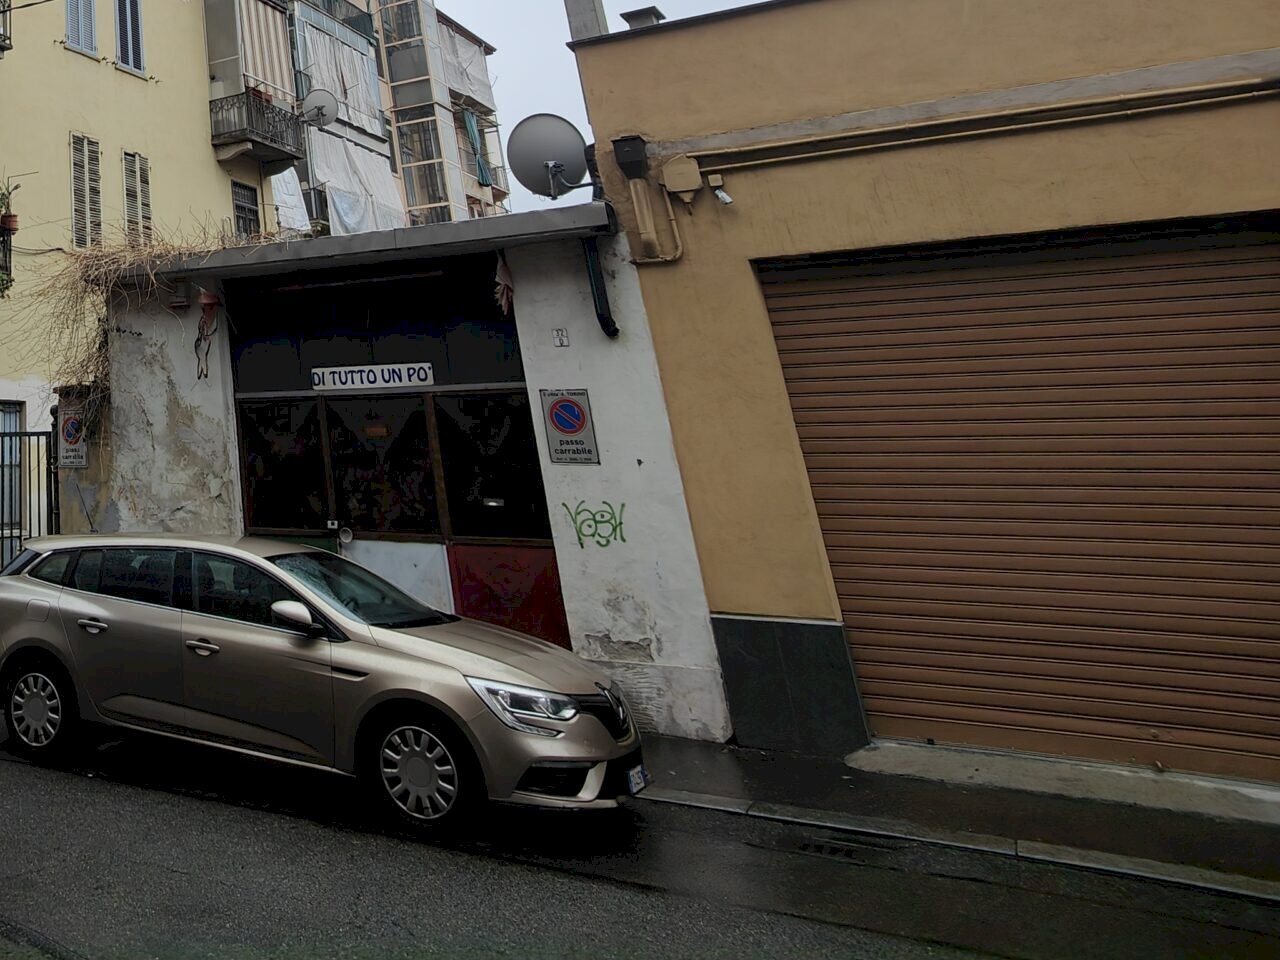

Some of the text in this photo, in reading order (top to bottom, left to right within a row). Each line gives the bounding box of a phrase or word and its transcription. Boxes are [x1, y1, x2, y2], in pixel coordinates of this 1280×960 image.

[312, 366, 431, 386] DI TUTTO UN PO'
[554, 447, 593, 455] carrabile
